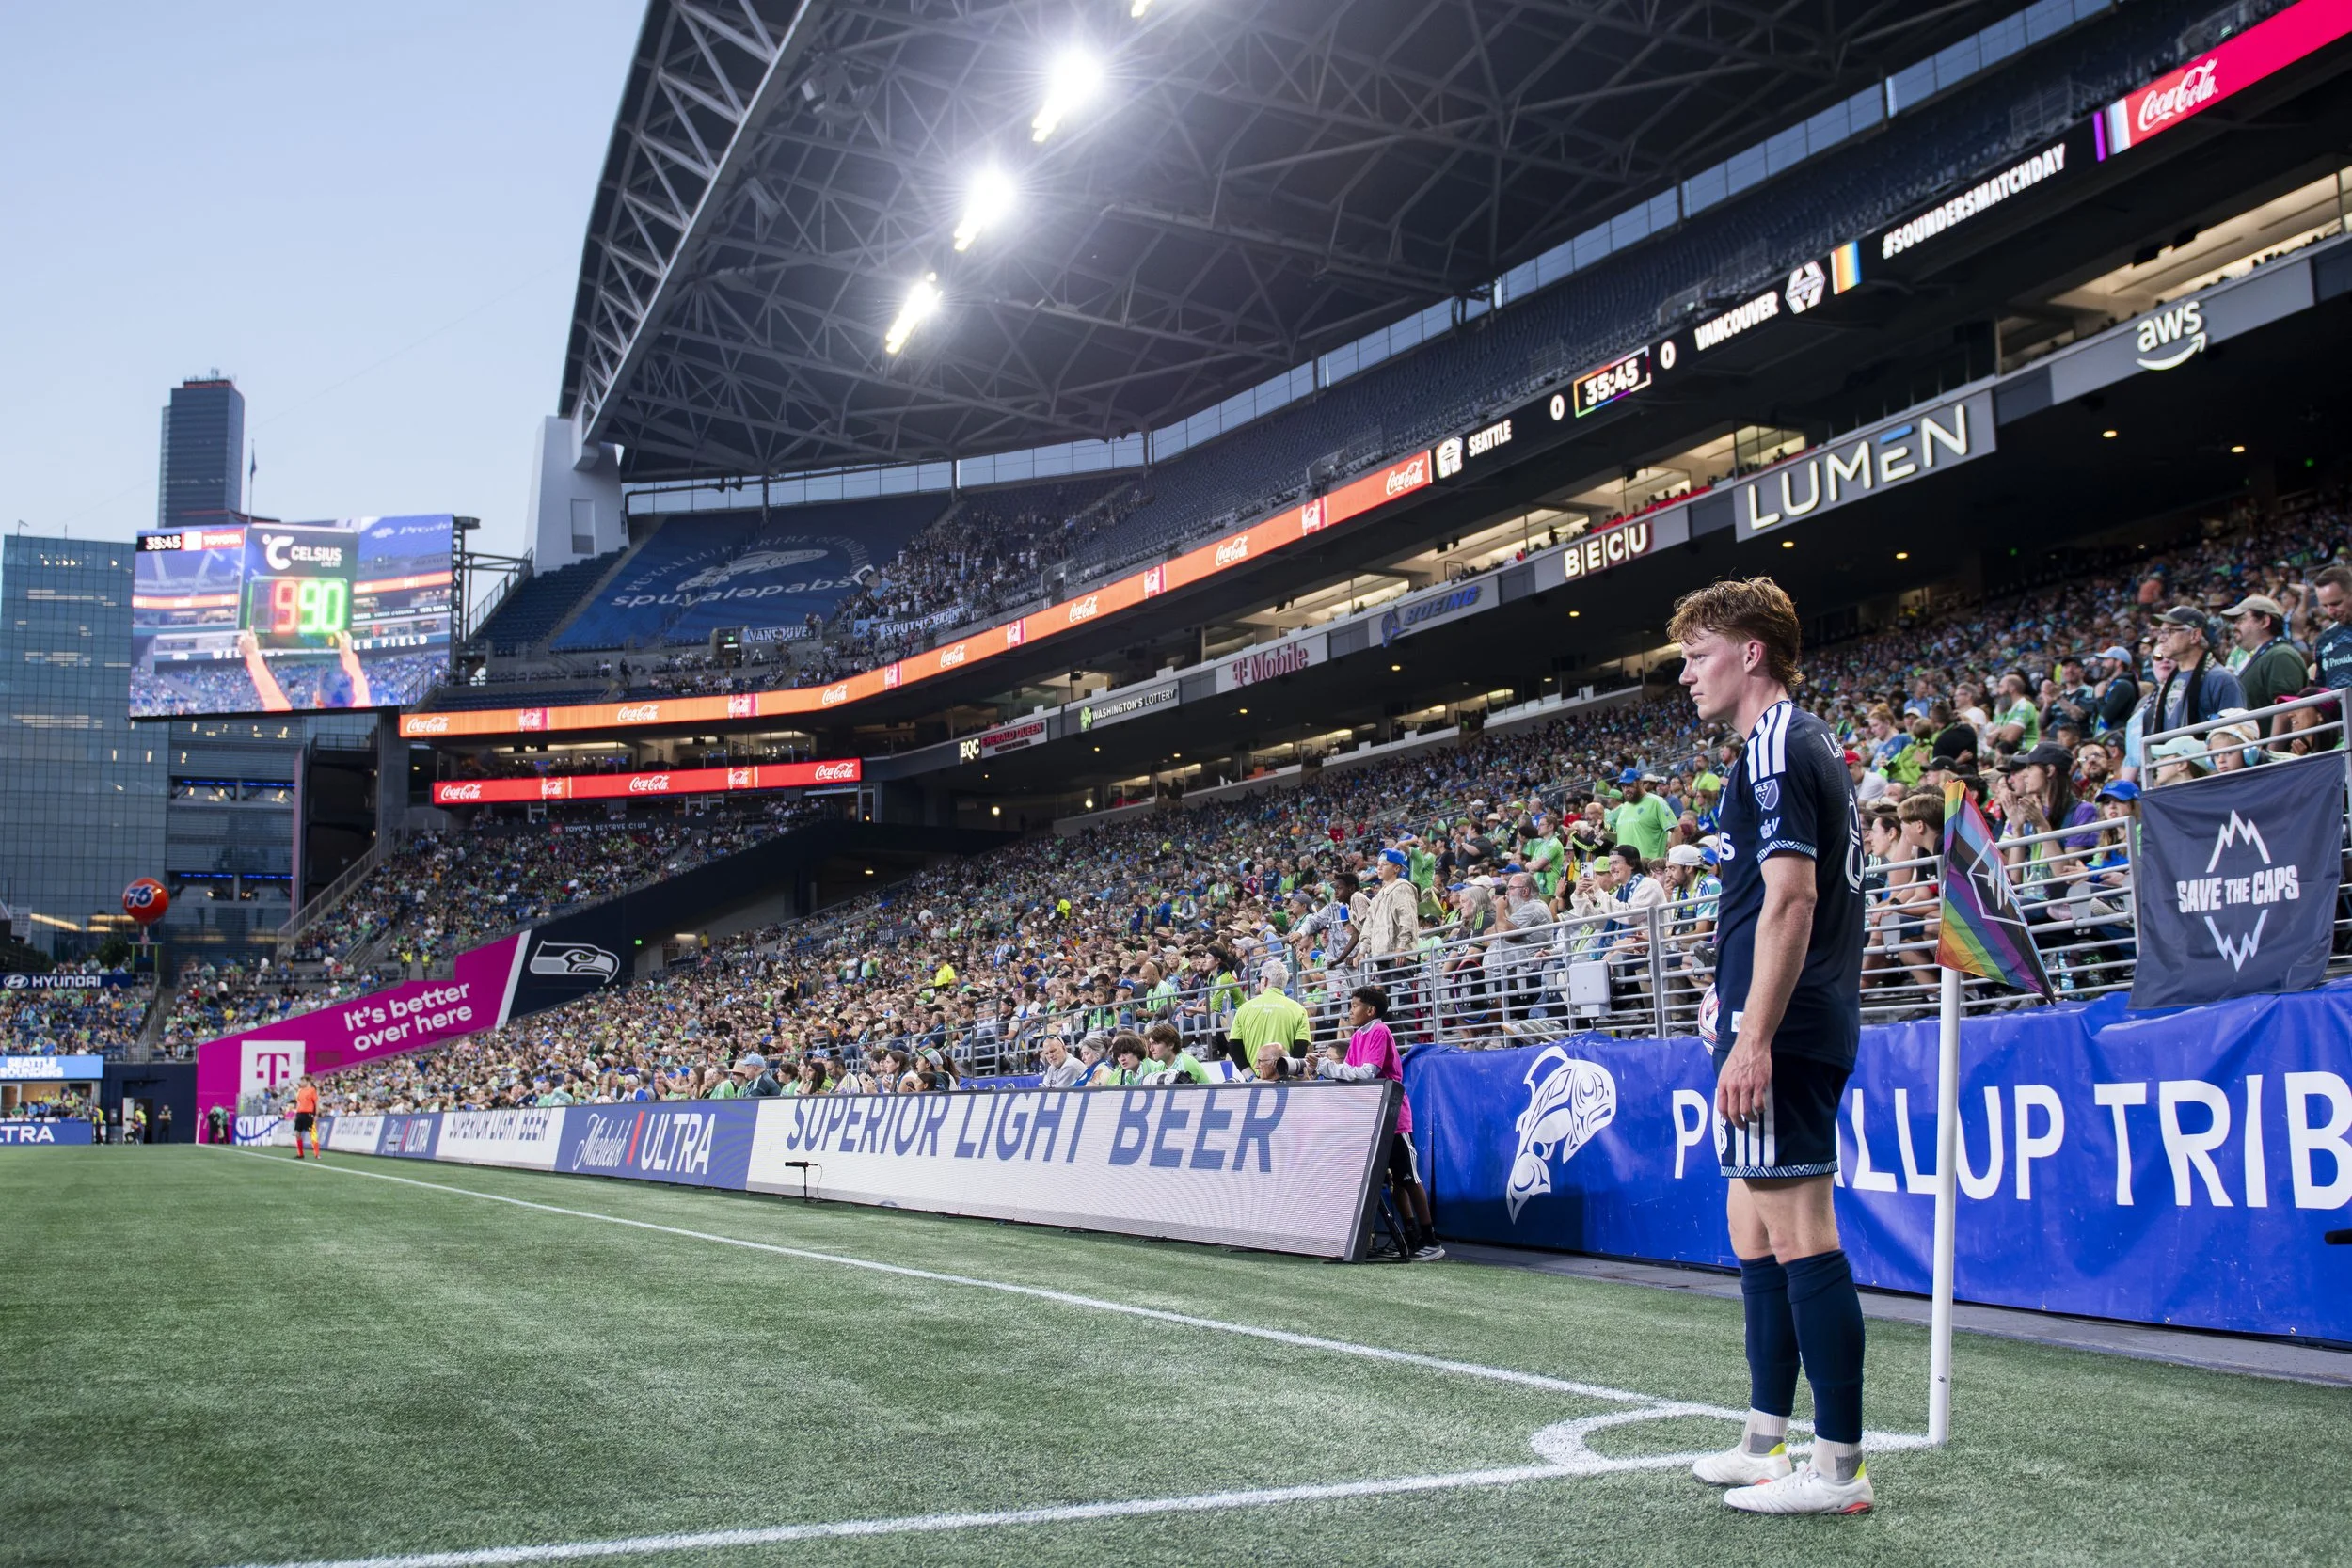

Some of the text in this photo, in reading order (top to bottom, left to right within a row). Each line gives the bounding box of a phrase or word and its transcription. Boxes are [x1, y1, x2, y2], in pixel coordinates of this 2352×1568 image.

[1882, 143, 2065, 260] #SOUNDERSMATCHDAY
[2137, 301, 2203, 353] aws
[1468, 291, 1779, 458] SEATTLE 0 35:45 0 VANCOUVER
[1748, 404, 1967, 530] LUMEN
[146, 533, 242, 551] 35:45 TOYOTA
[291, 546, 342, 562] CELSIUS
[1403, 586, 1482, 626] BOEING
[1092, 689, 1175, 721] WASHINGTON'S LOTTERY
[960, 738, 980, 761] EQC
[981, 730, 1015, 748] EMERALD
[1015, 721, 1044, 738] QUEEN
[1755, 784, 1769, 793] MLS
[126, 884, 154, 908] 76
[2176, 864, 2300, 913] SAVE THE CAPS
[32, 975, 102, 988] HYUNDAI
[343, 982, 470, 1032] It's better
[353, 1004, 473, 1052] over here
[7, 1056, 57, 1068] SEATTLE
[0, 1126, 55, 1143] TRA
[518, 1108, 552, 1141] BEER
[786, 1087, 1289, 1173] SUPERIOR LIGHT BEER
[572, 1112, 716, 1175] Michelob ULTRA
